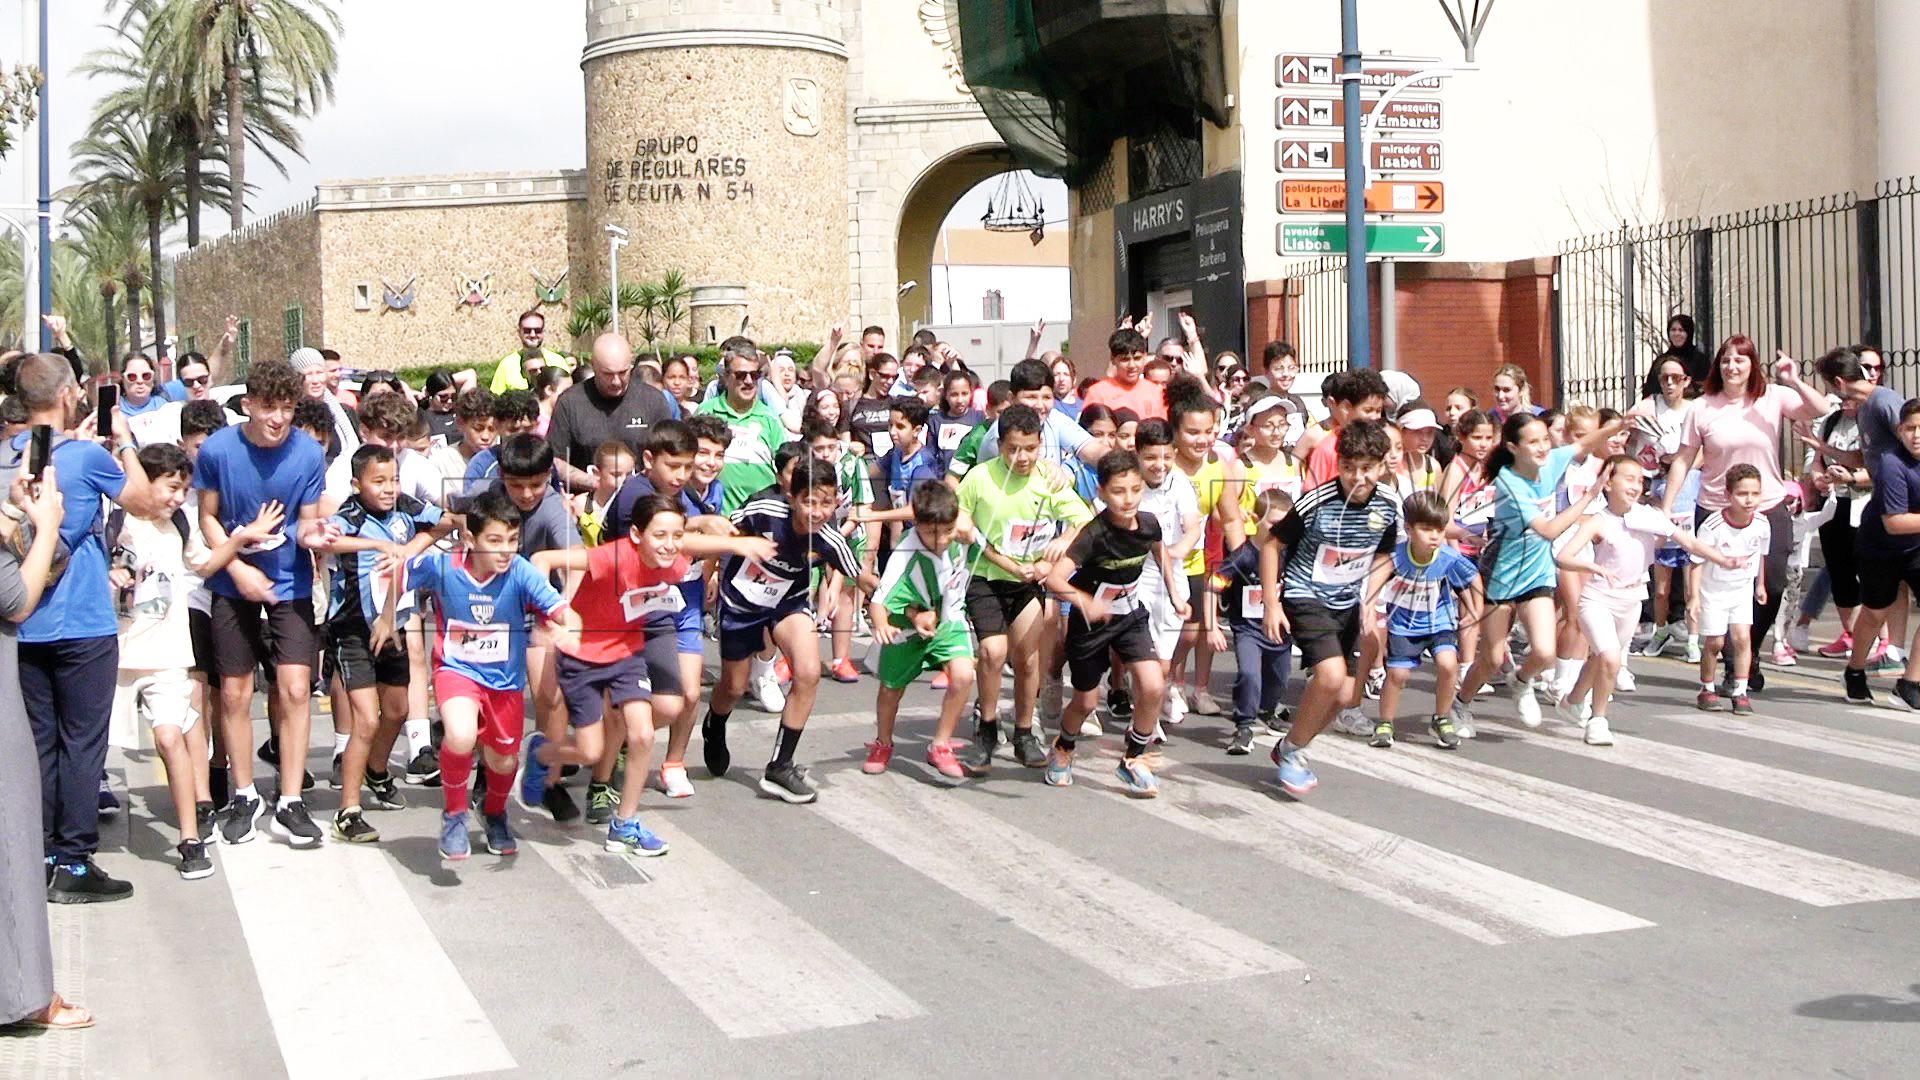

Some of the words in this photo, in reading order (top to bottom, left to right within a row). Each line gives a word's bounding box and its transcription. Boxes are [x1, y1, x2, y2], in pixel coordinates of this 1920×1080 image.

[1392, 103, 1439, 113] mezquita
[1378, 114, 1439, 128] Embarek
[635, 135, 698, 157] GRUPO
[1380, 144, 1421, 154] mirador
[1426, 144, 1439, 154] de
[1380, 155, 1423, 168] Isabel
[606, 160, 622, 180] DE
[631, 158, 746, 180] REGULARES
[604, 183, 620, 203] DE
[627, 183, 683, 203] CEUTA
[698, 183, 710, 200] N
[1285, 184, 1346, 194] polideportiv
[1286, 197, 1300, 208] La
[1133, 198, 1184, 233] HARRY'S
[1284, 226, 1325, 236] avenida
[1284, 238, 1332, 251] Lisboa
[479, 640, 498, 650] 237
